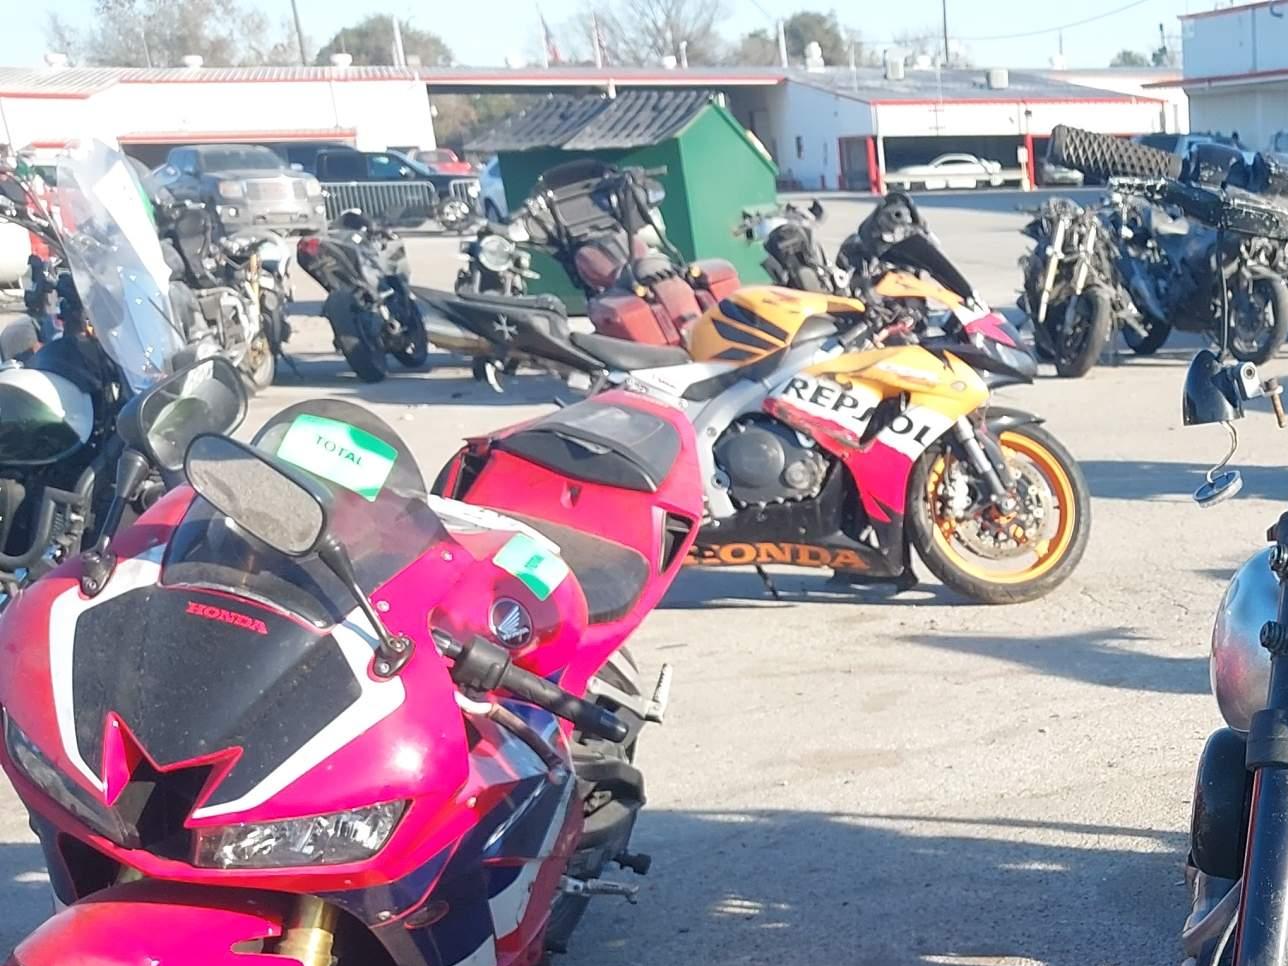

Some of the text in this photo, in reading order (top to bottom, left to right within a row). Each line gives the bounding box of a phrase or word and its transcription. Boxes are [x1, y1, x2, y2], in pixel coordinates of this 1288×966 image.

[316, 435, 363, 465] TOTAL
[682, 542, 871, 571] HONDA
[186, 601, 268, 634] HONDA
